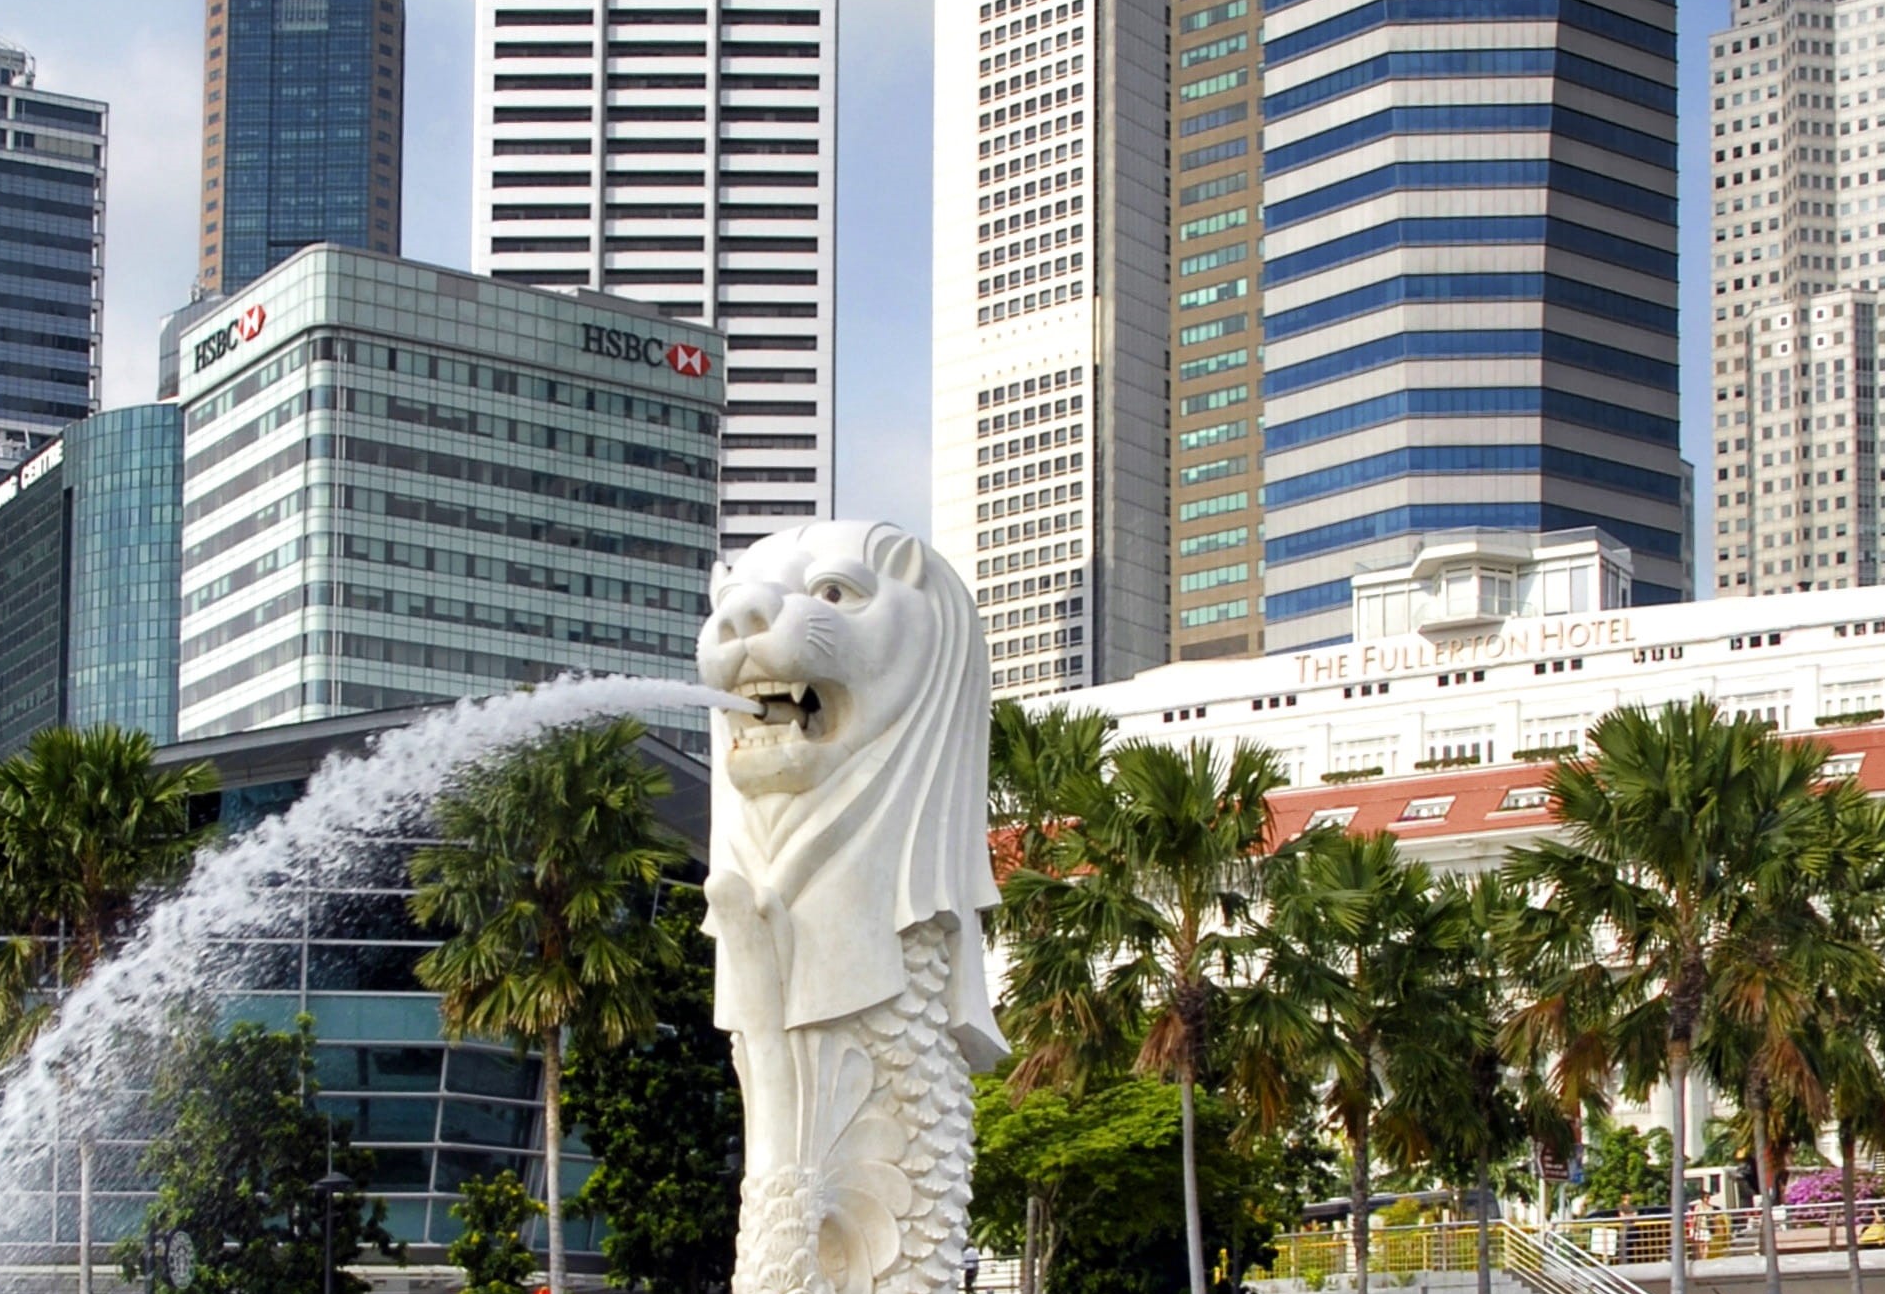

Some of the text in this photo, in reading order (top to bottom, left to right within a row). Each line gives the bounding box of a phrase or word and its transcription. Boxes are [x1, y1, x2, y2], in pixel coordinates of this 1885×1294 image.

[194, 319, 239, 374] HSBC
[581, 323, 663, 367] HSBC
[20, 439, 65, 490] CENTRE
[1295, 617, 1636, 684] THE FULLERTON HOTEL
